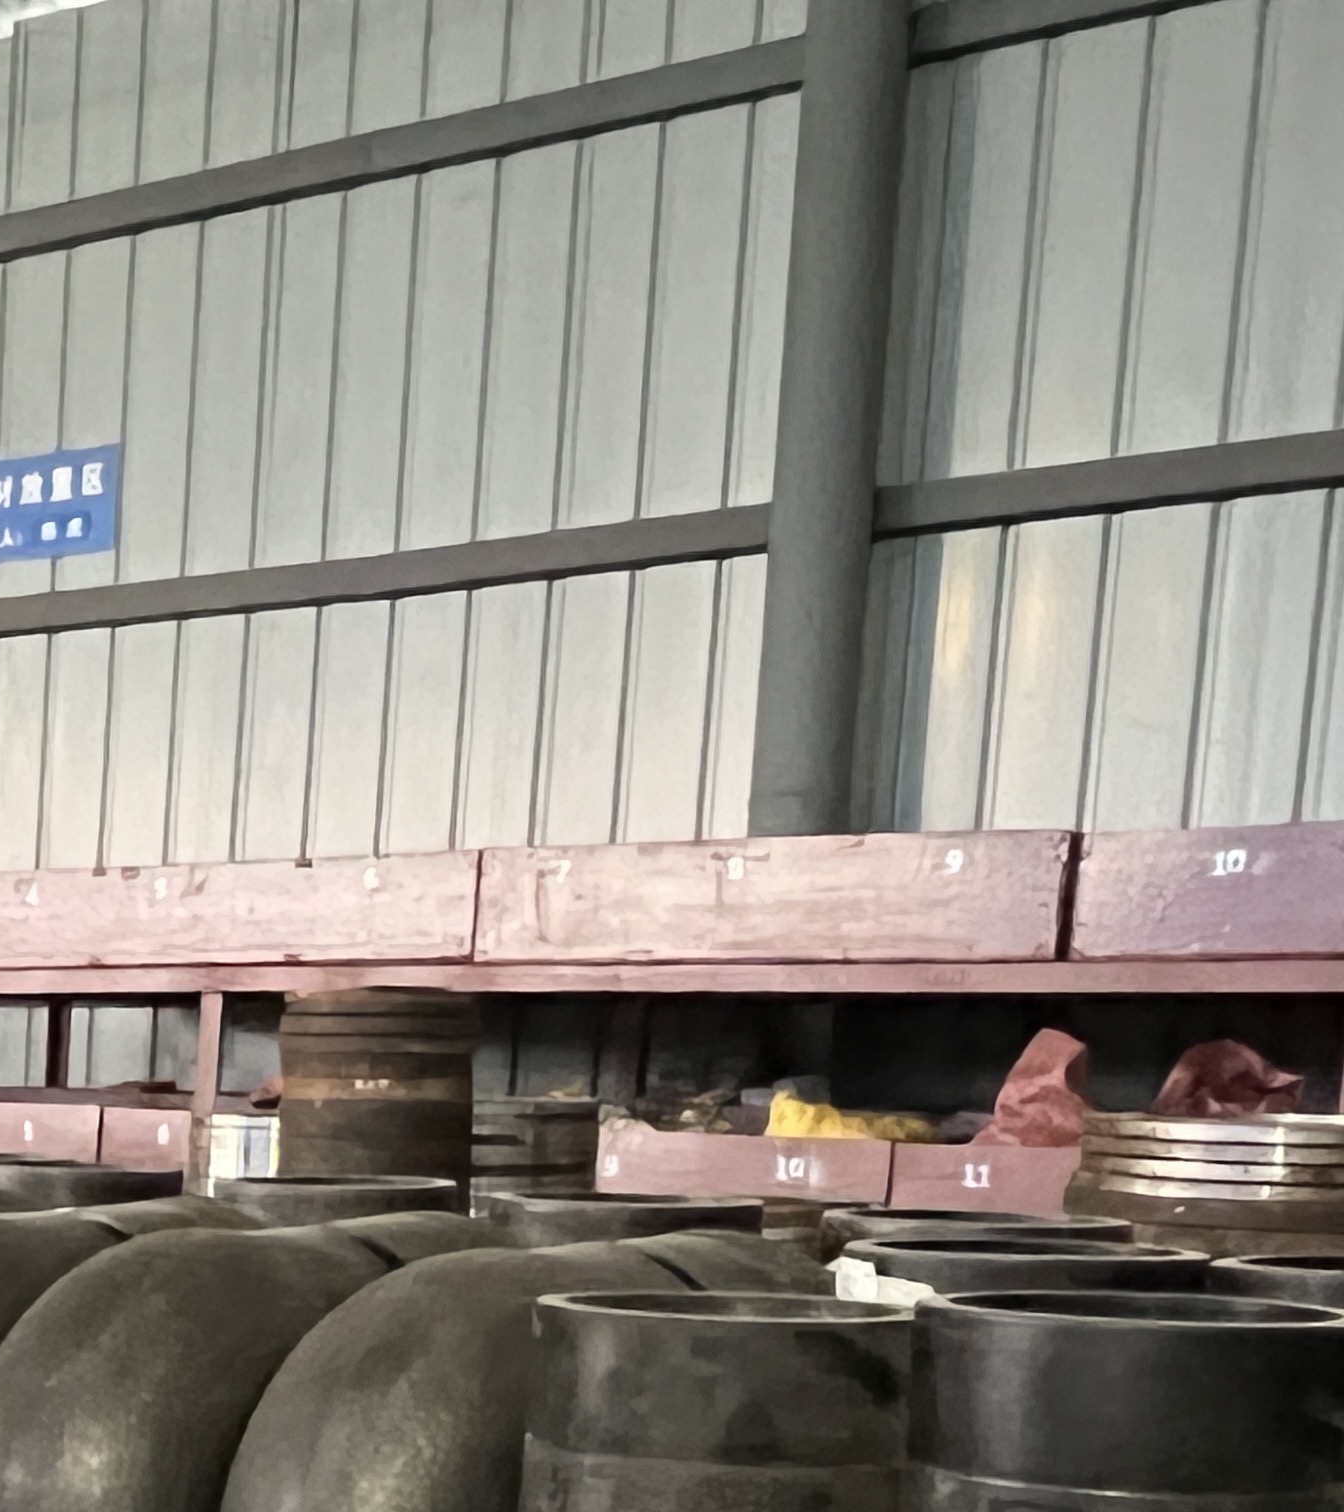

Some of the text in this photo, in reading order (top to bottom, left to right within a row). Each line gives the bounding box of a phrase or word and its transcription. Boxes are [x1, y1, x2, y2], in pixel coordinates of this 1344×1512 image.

[943, 849, 965, 876] 9
[1211, 849, 1247, 876] 10
[776, 1156, 805, 1181] 10
[962, 1163, 990, 1188] 11
